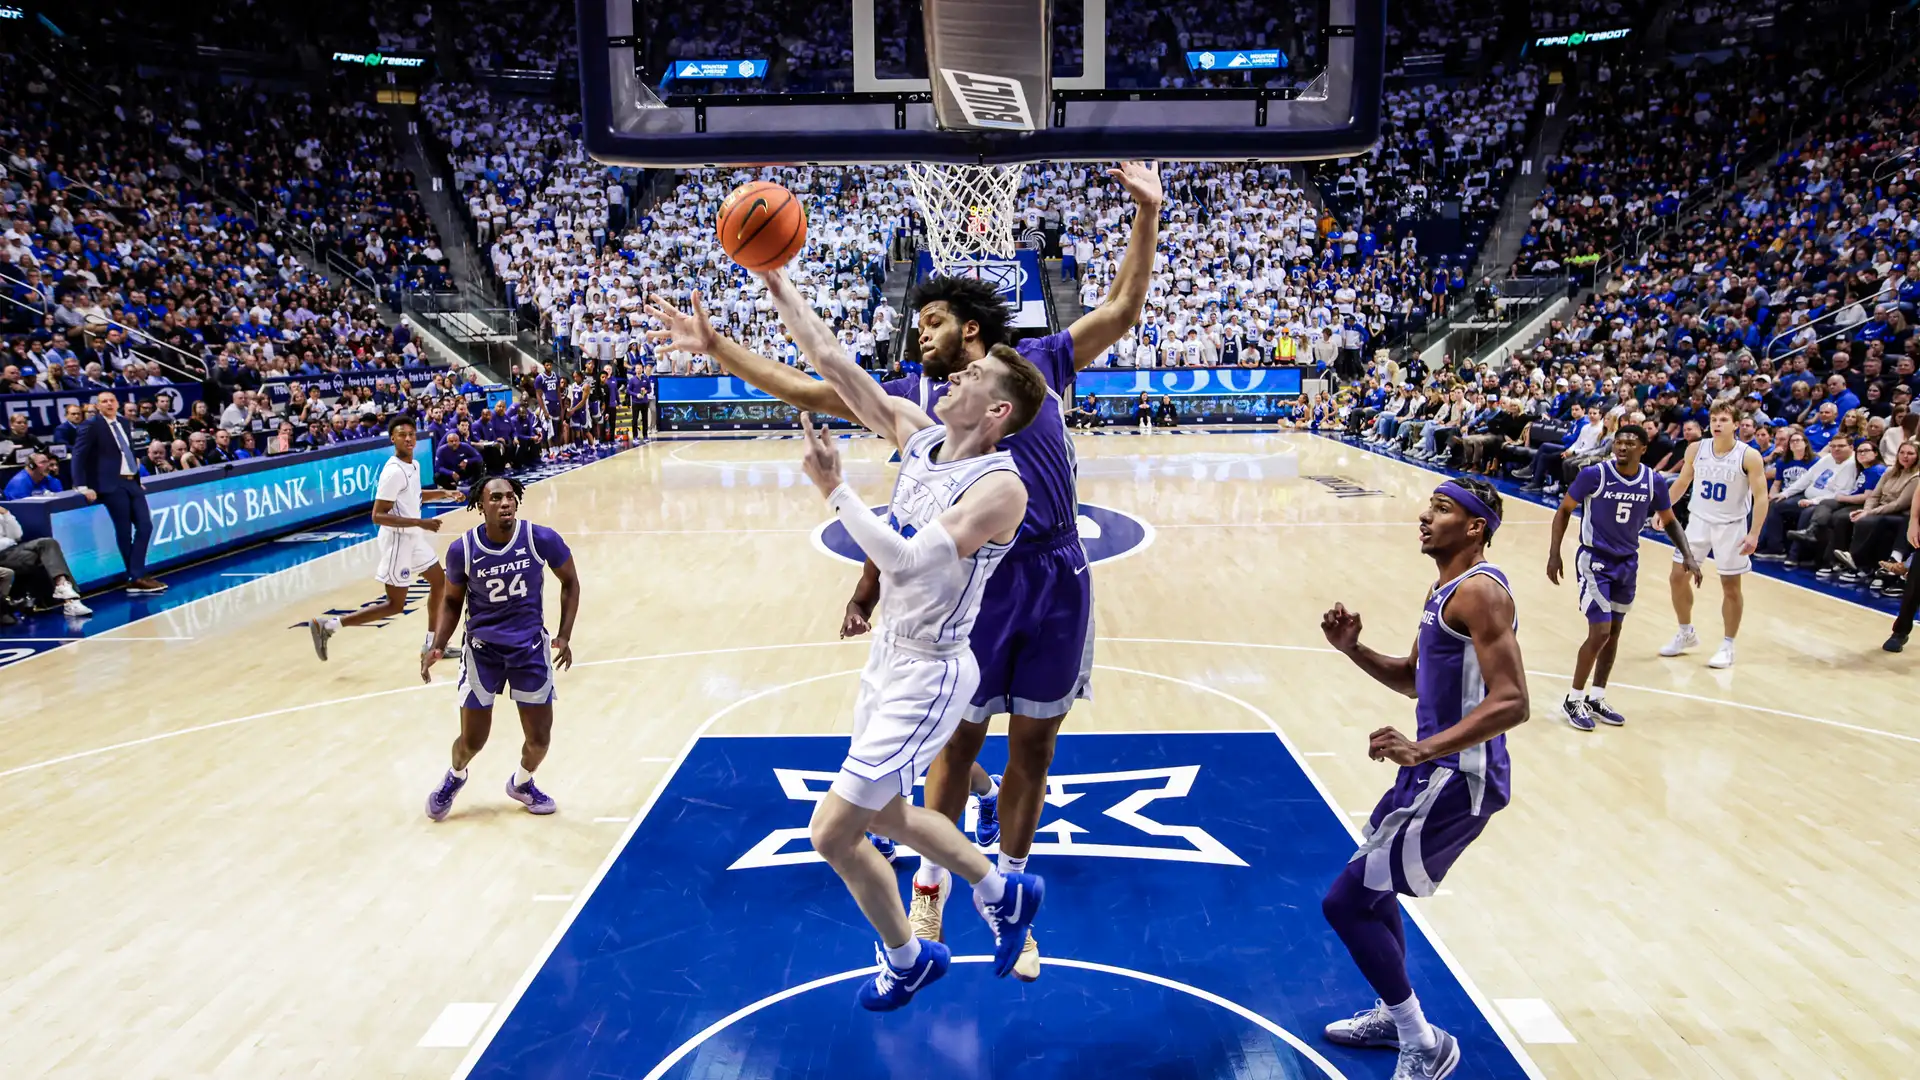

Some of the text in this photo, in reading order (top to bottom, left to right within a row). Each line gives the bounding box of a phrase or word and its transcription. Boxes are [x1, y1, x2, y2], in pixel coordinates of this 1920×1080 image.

[952, 72, 1025, 124] BUILT
[547, 382, 557, 391] 20
[1697, 465, 1736, 482] BYU
[1603, 491, 1648, 502] K-STATE
[1701, 480, 1727, 502] 30
[151, 492, 239, 546] ZIONS
[244, 476, 310, 521] BANK
[1616, 502, 1633, 524] 5
[477, 559, 530, 578] K-STATE
[486, 573, 528, 603] 24
